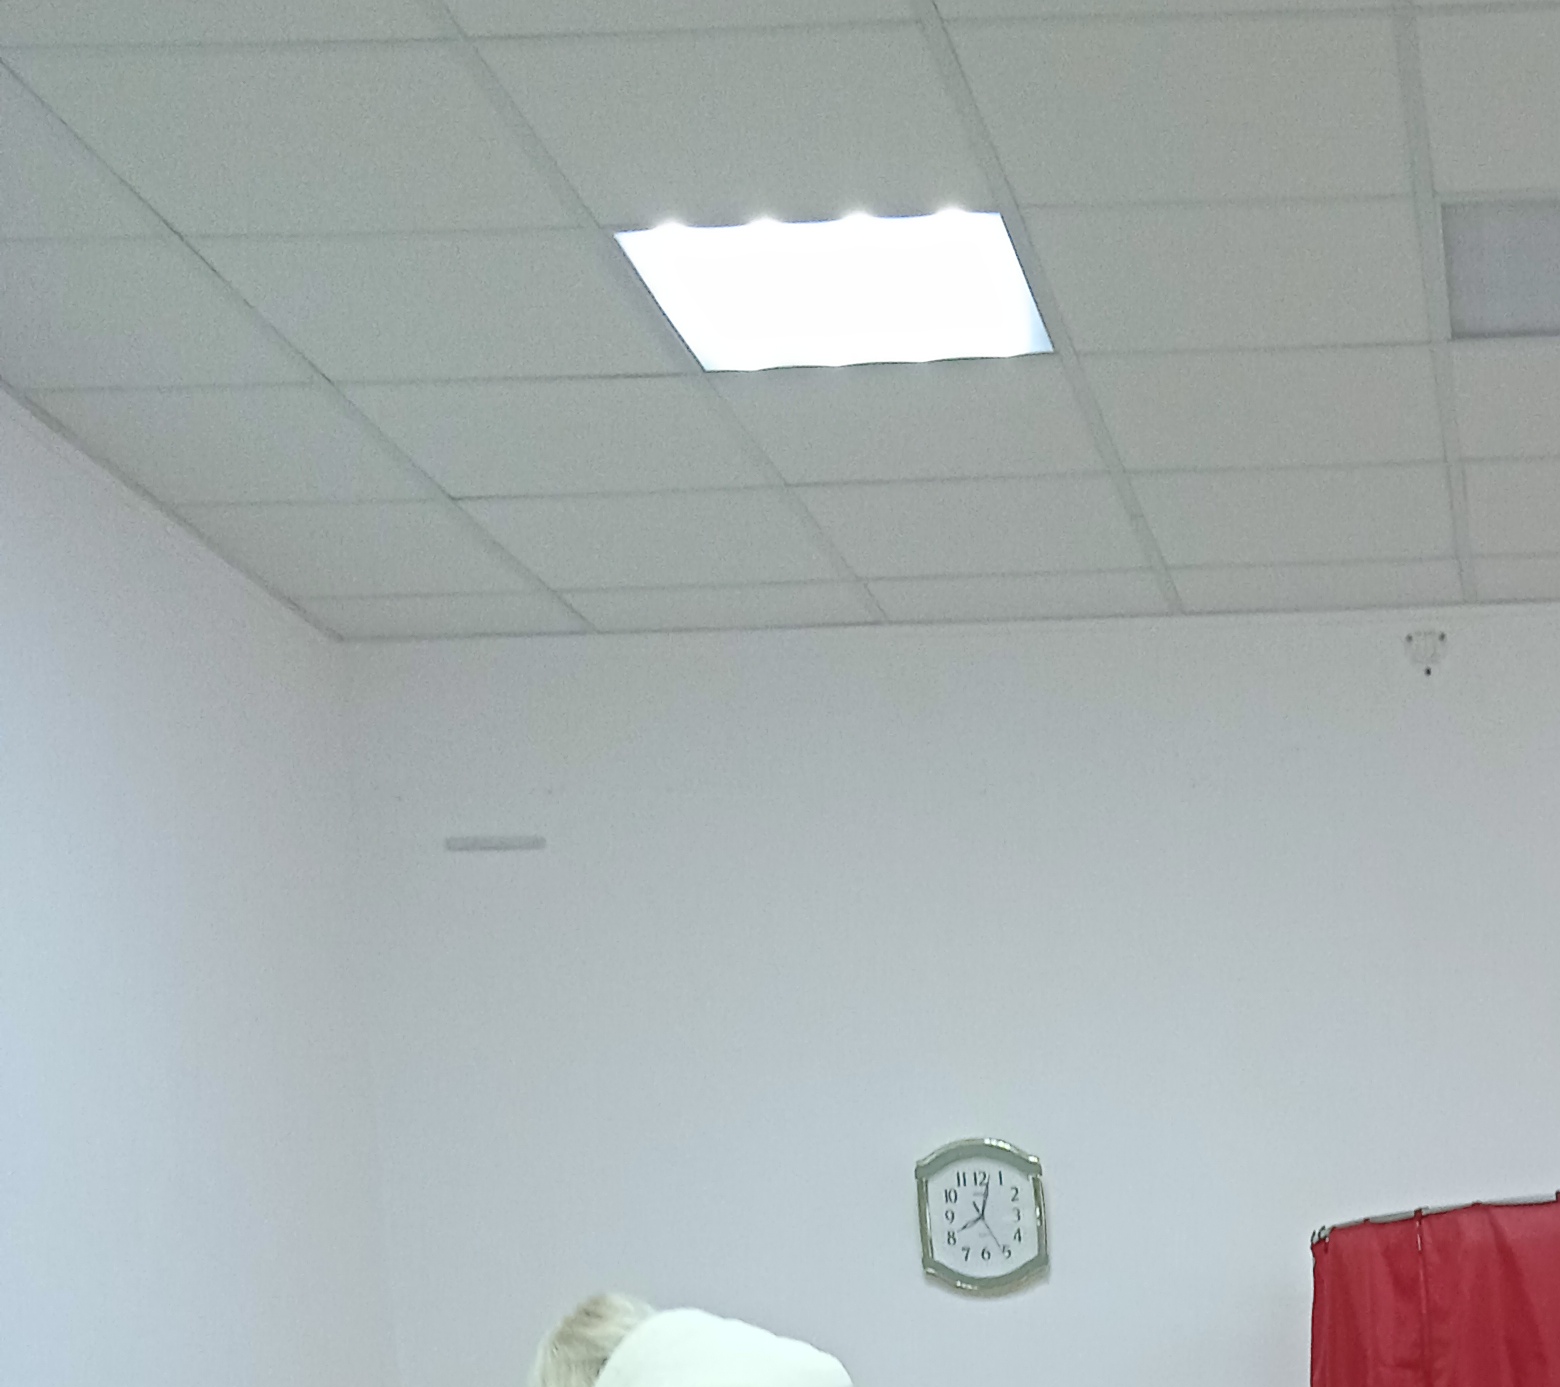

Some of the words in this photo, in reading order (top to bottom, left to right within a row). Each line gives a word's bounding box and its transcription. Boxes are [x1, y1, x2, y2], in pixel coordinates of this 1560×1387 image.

[957, 1171, 967, 1187] 11
[973, 1171, 987, 1186] 12
[944, 1188, 958, 1203] 10
[1010, 1186, 1020, 1202] 2
[944, 1209, 955, 1224] 9
[1012, 1207, 1021, 1222] 3
[947, 1230, 957, 1246] 8
[1013, 1227, 1022, 1242] 4
[961, 1245, 970, 1262] 7
[981, 1246, 991, 1260] 6
[1002, 1244, 1012, 1259] 5
